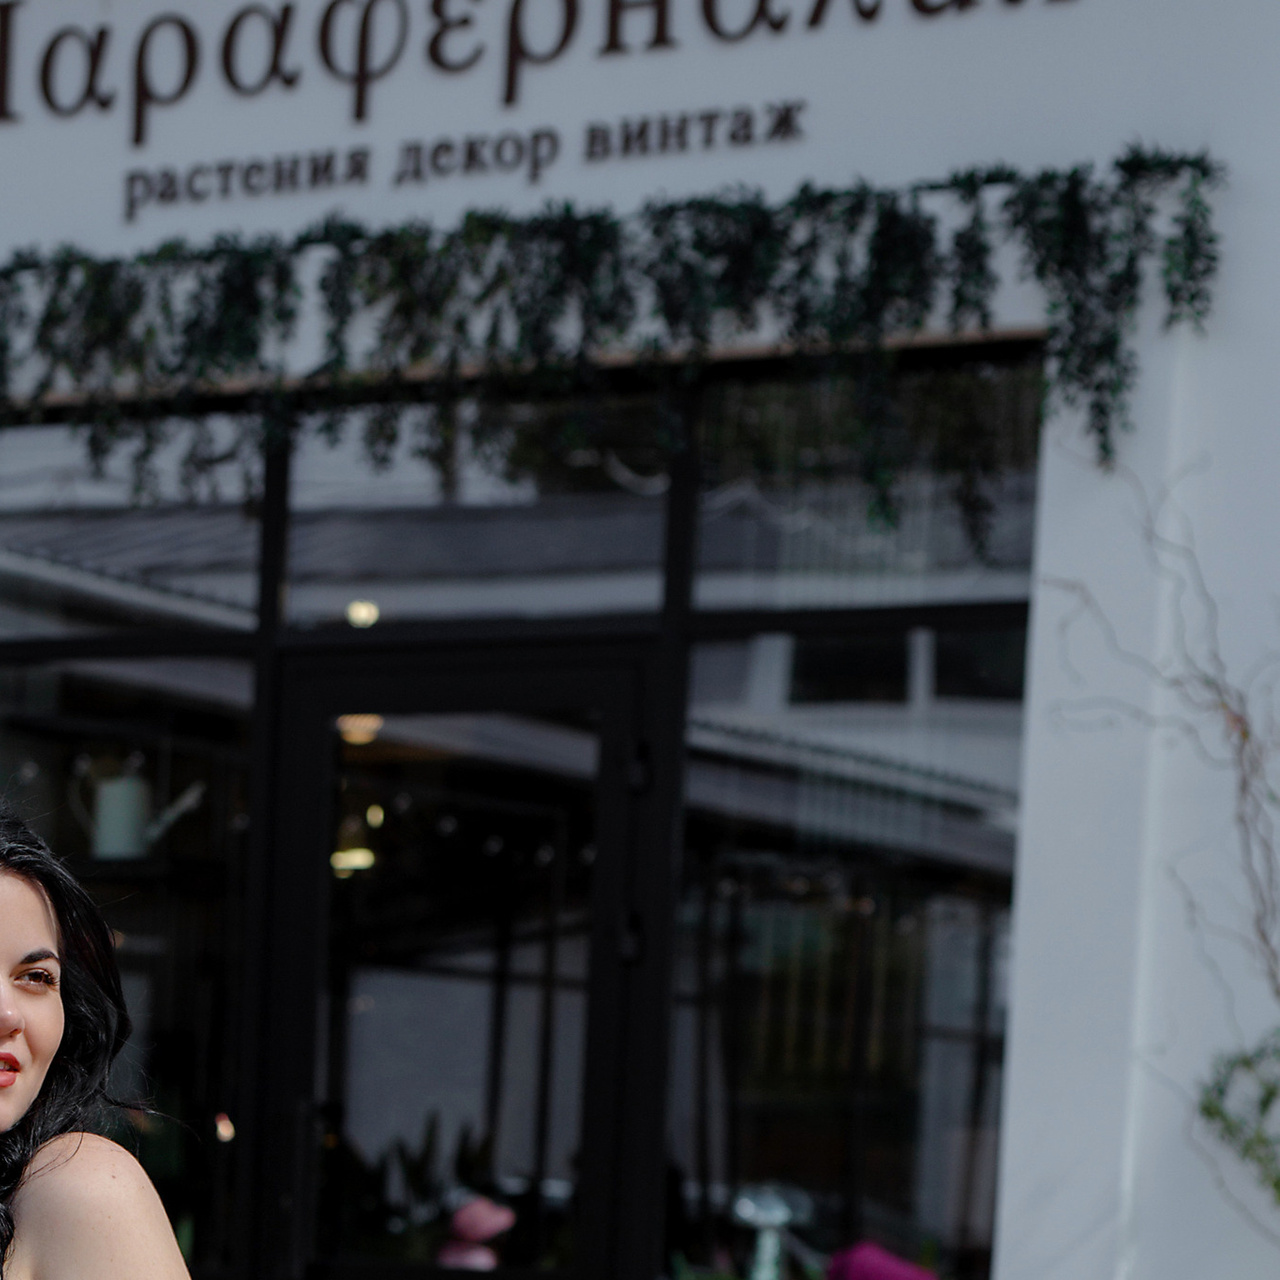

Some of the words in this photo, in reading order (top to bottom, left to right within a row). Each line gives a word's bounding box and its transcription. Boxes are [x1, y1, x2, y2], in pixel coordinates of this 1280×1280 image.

[123, 145, 371, 222] растения
[393, 128, 561, 187] декор
[583, 101, 806, 164] винтаж
